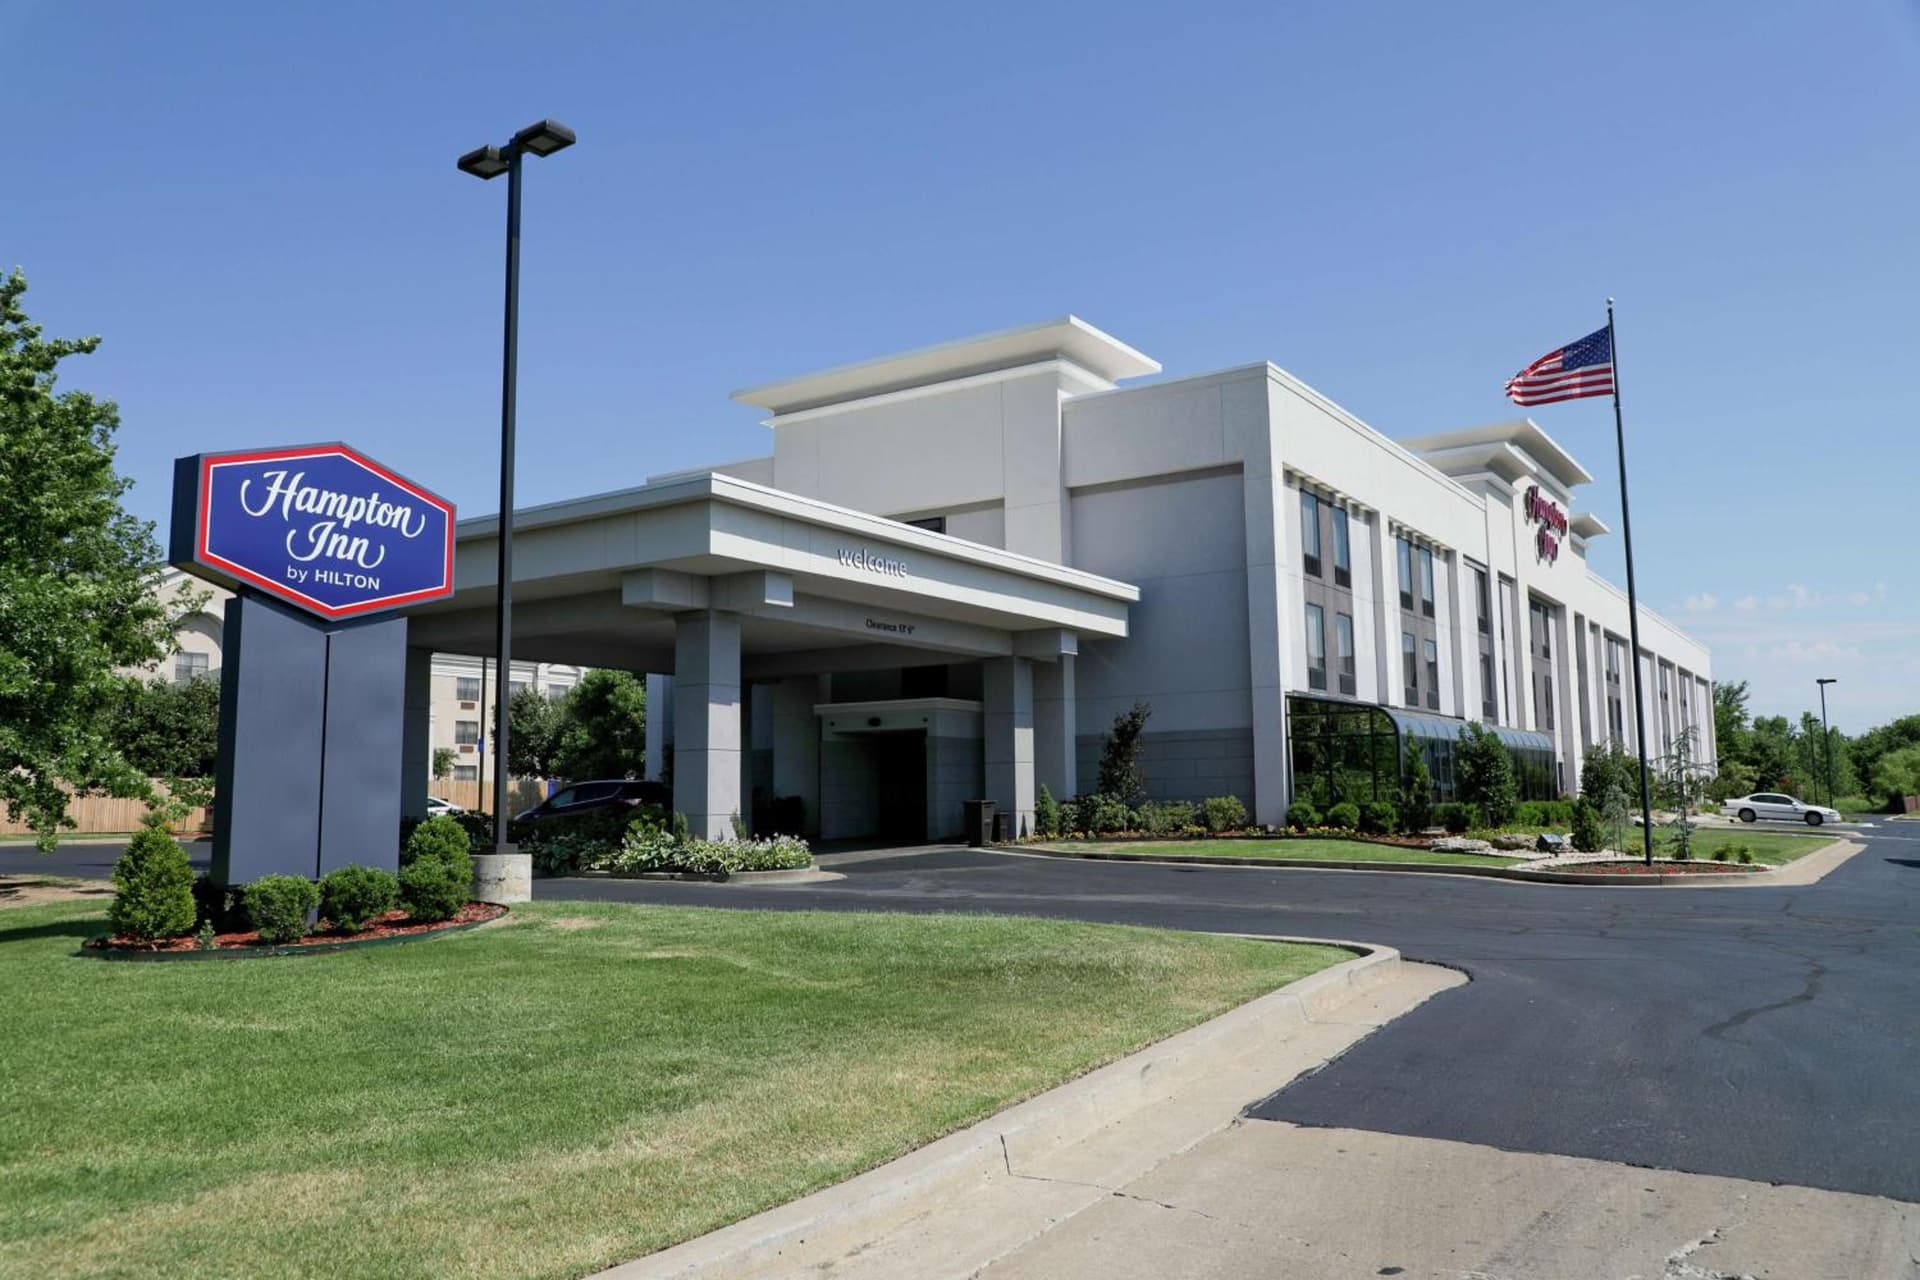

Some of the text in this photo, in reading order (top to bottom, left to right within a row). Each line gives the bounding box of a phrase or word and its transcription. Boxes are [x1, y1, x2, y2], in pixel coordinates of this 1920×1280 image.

[240, 470, 426, 538] Hampton
[286, 521, 385, 569] Inn
[837, 548, 908, 577] welcome
[287, 565, 380, 590] by HILTON
